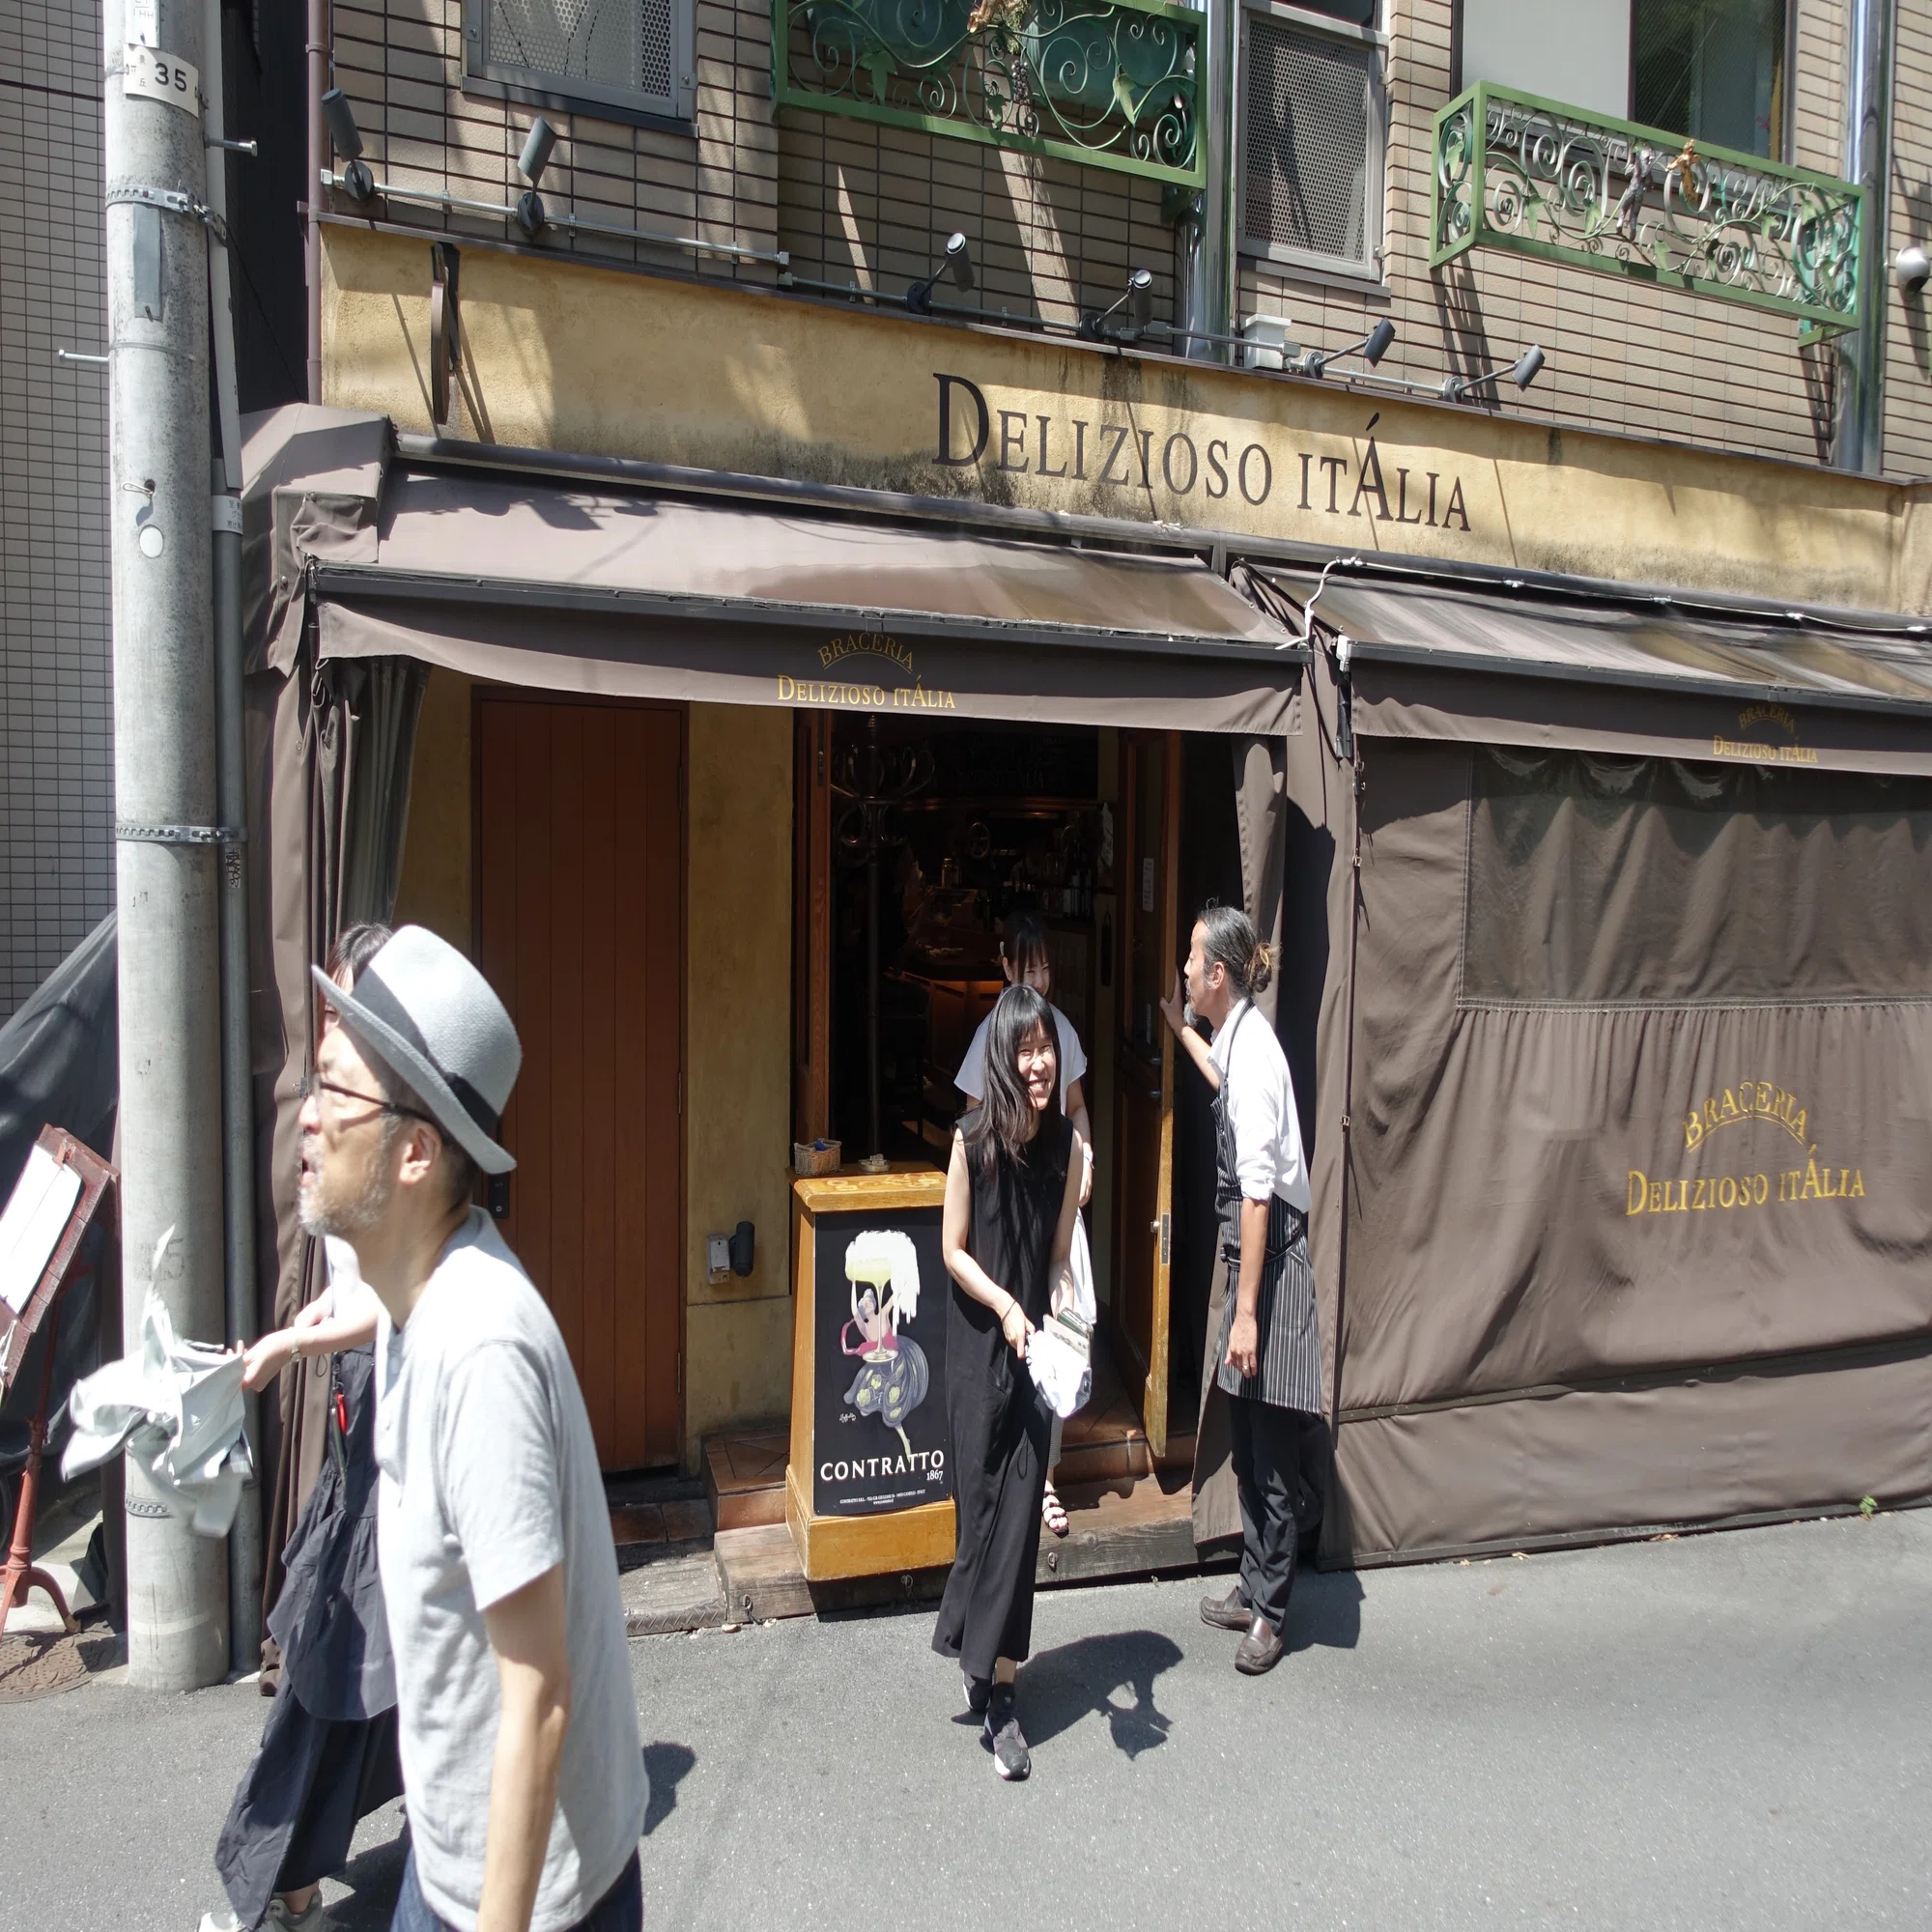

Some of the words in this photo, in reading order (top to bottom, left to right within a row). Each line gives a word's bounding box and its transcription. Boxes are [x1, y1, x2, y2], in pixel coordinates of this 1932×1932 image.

[155, 62, 187, 93] 35
[931, 372, 1272, 506] DELIZIOSO
[817, 632, 914, 672] BRACERIA
[777, 674, 886, 706] DELIZIOSO
[1739, 703, 1796, 732] BRACERIA
[1713, 734, 1776, 761] DELIZIOSO
[1682, 1081, 1807, 1149] BRACERIA
[1626, 1169, 1770, 1216] DELIZIOSO
[820, 1449, 945, 1482] CONTRATTO
[926, 1468, 944, 1482] 1867
